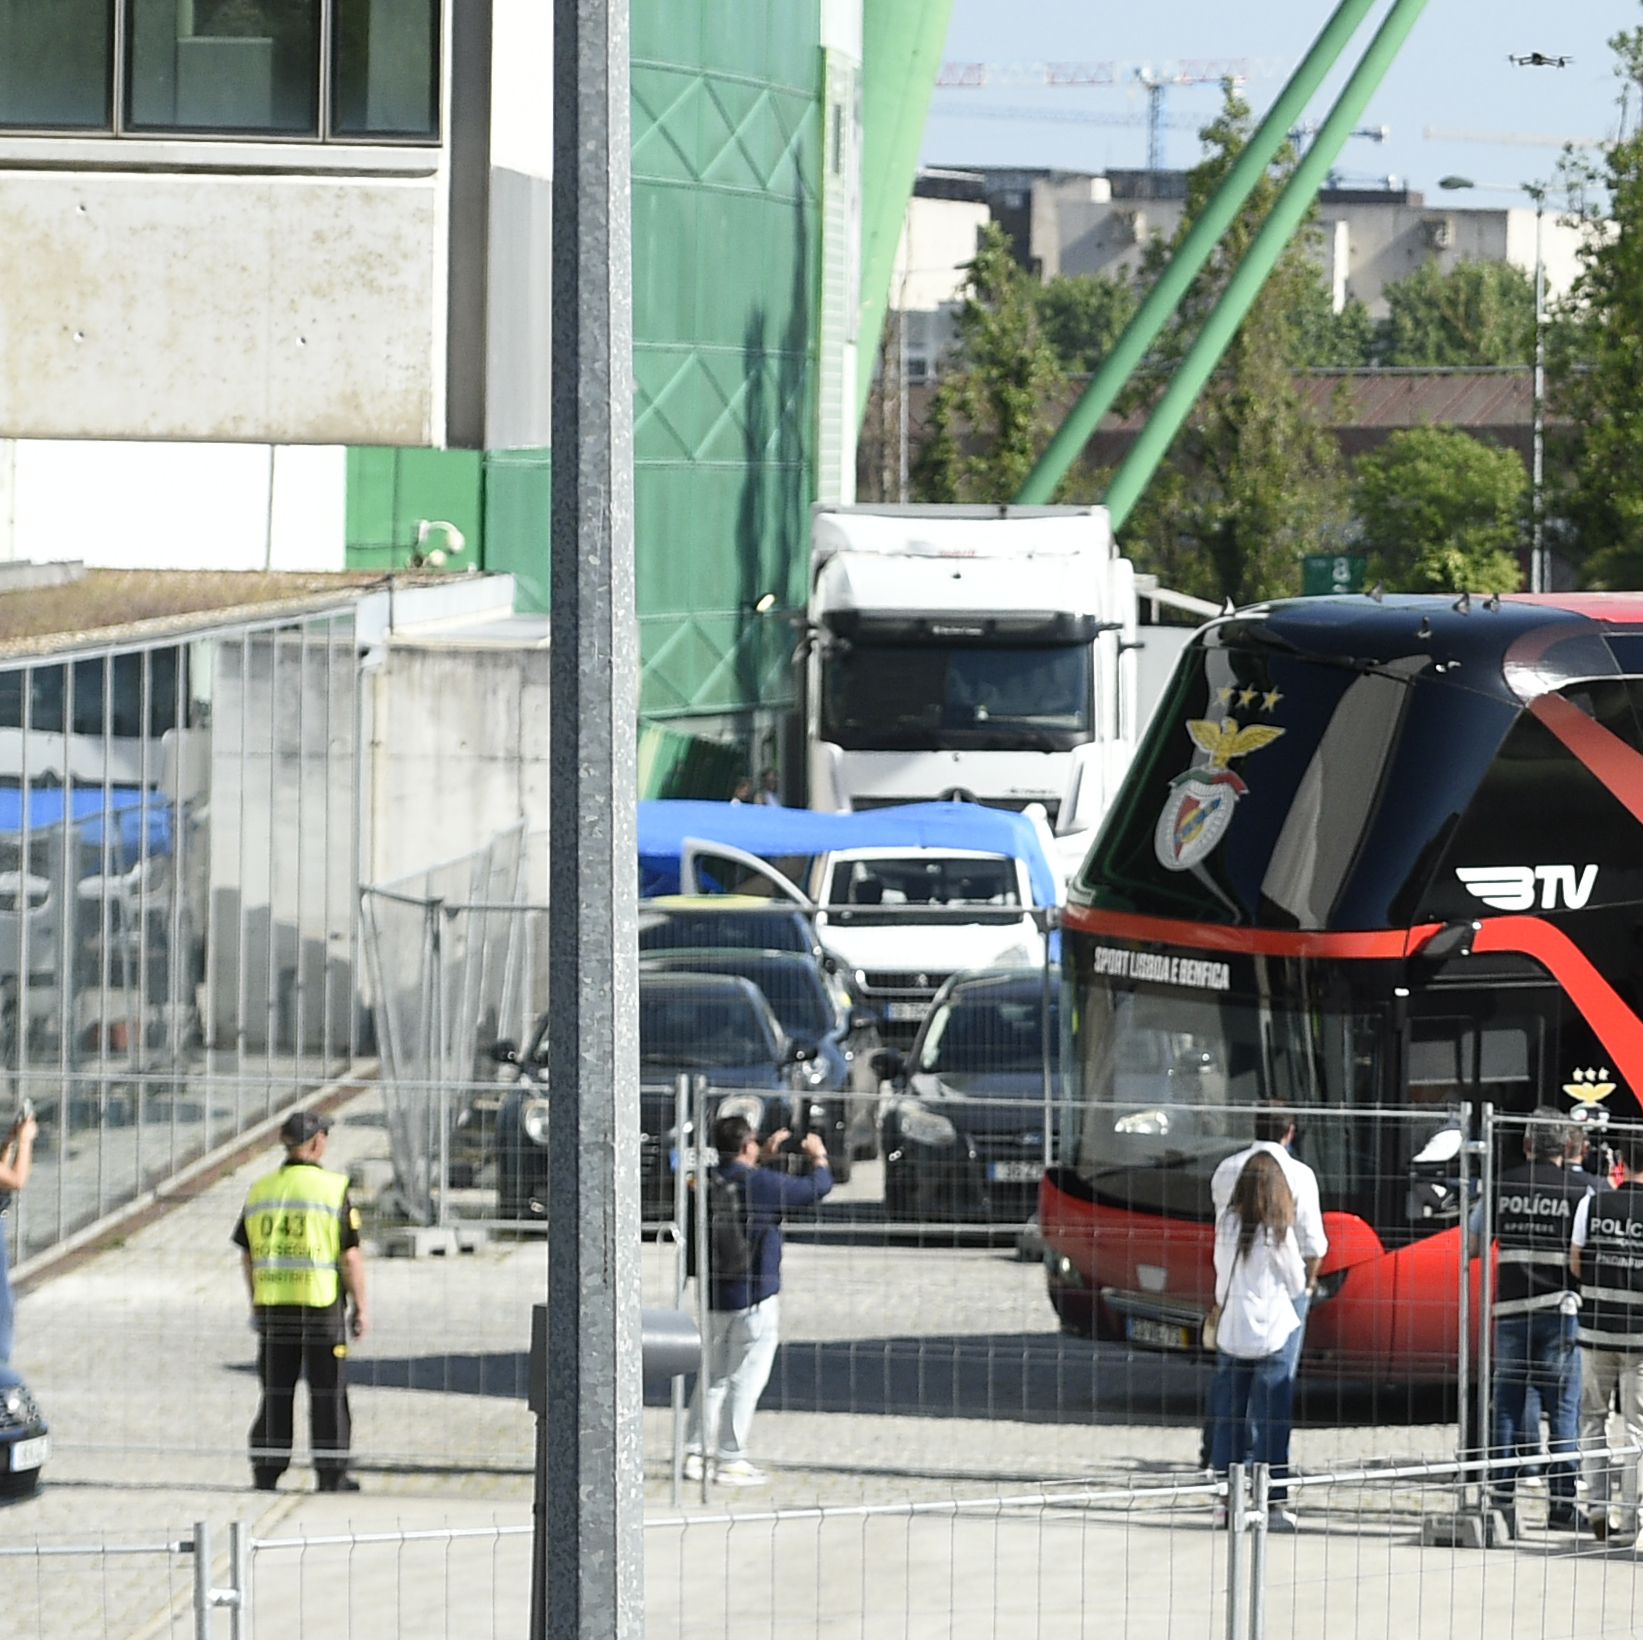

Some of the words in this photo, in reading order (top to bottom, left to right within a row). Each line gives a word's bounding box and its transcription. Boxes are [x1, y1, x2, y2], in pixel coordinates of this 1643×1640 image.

[1456, 864, 1599, 911] BTV
[1094, 946, 1130, 976] SPORT
[1129, 952, 1170, 983] LISBOA
[1170, 957, 1179, 984] E
[1179, 958, 1230, 990] BENFICA
[1499, 1193, 1569, 1218] POLÍCIA
